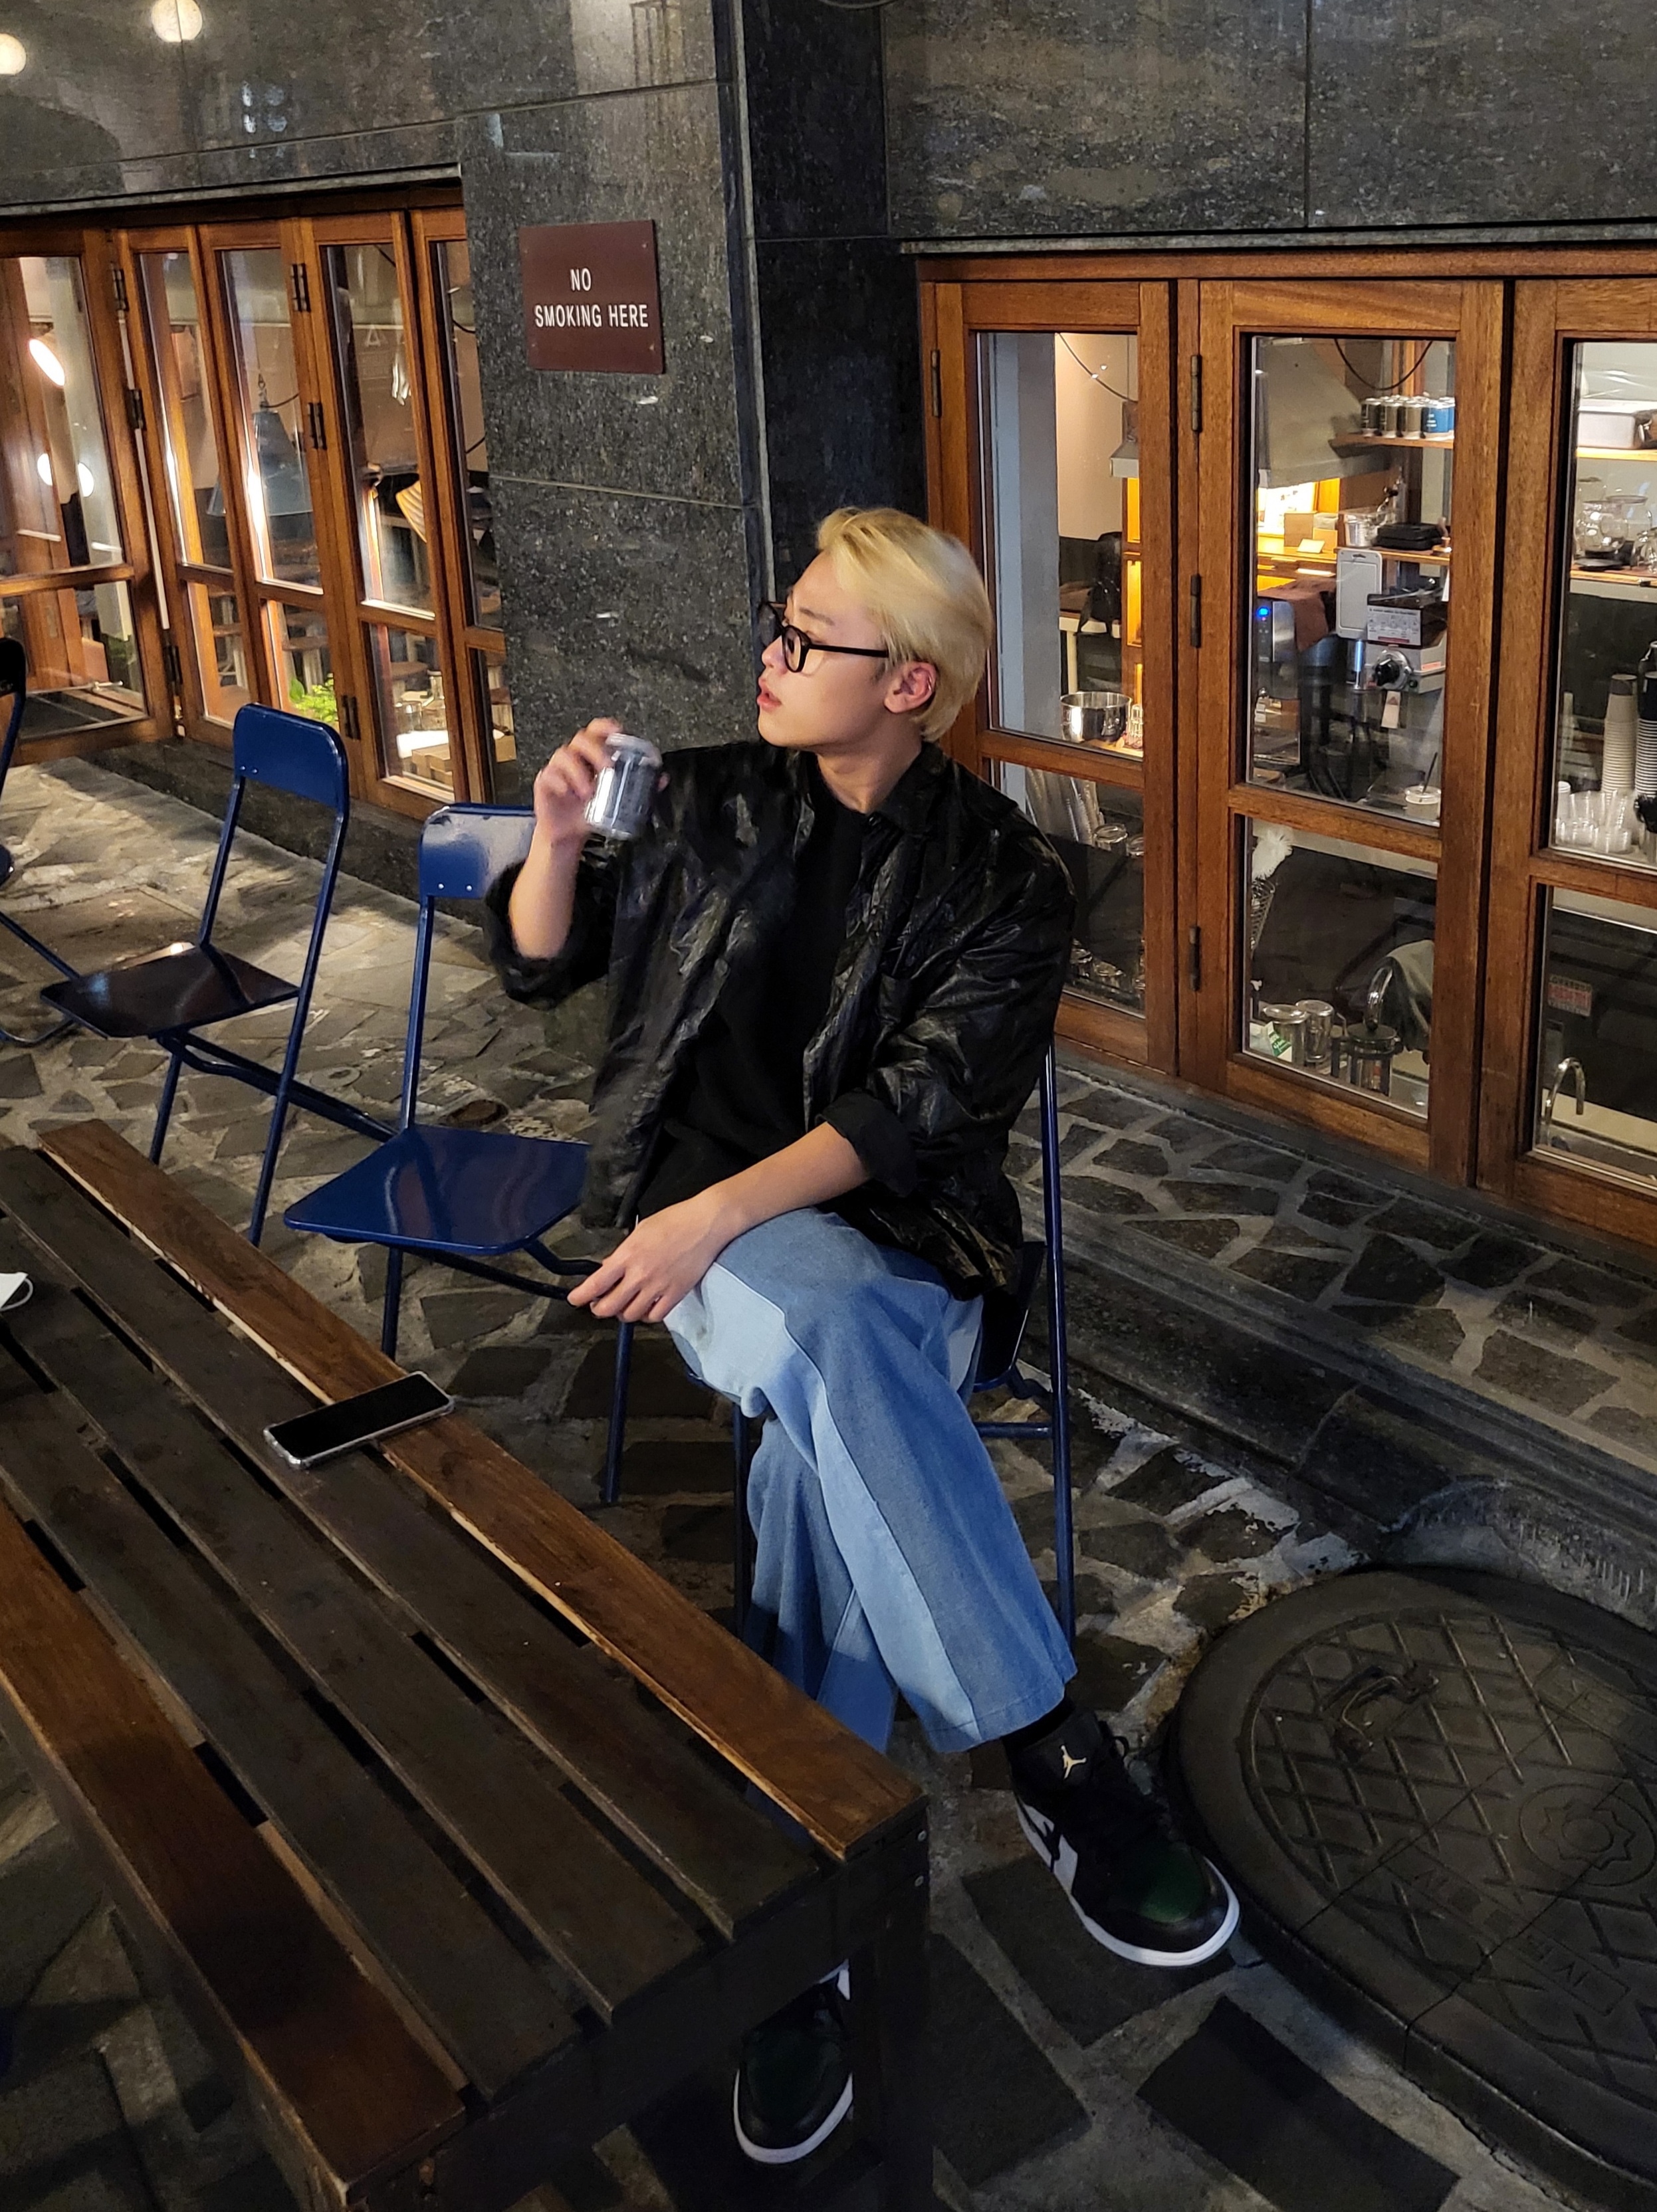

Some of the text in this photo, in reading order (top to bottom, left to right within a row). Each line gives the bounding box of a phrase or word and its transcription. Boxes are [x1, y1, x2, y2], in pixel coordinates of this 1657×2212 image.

[570, 267, 592, 291] NO
[534, 304, 649, 328] SMOKING HERE
